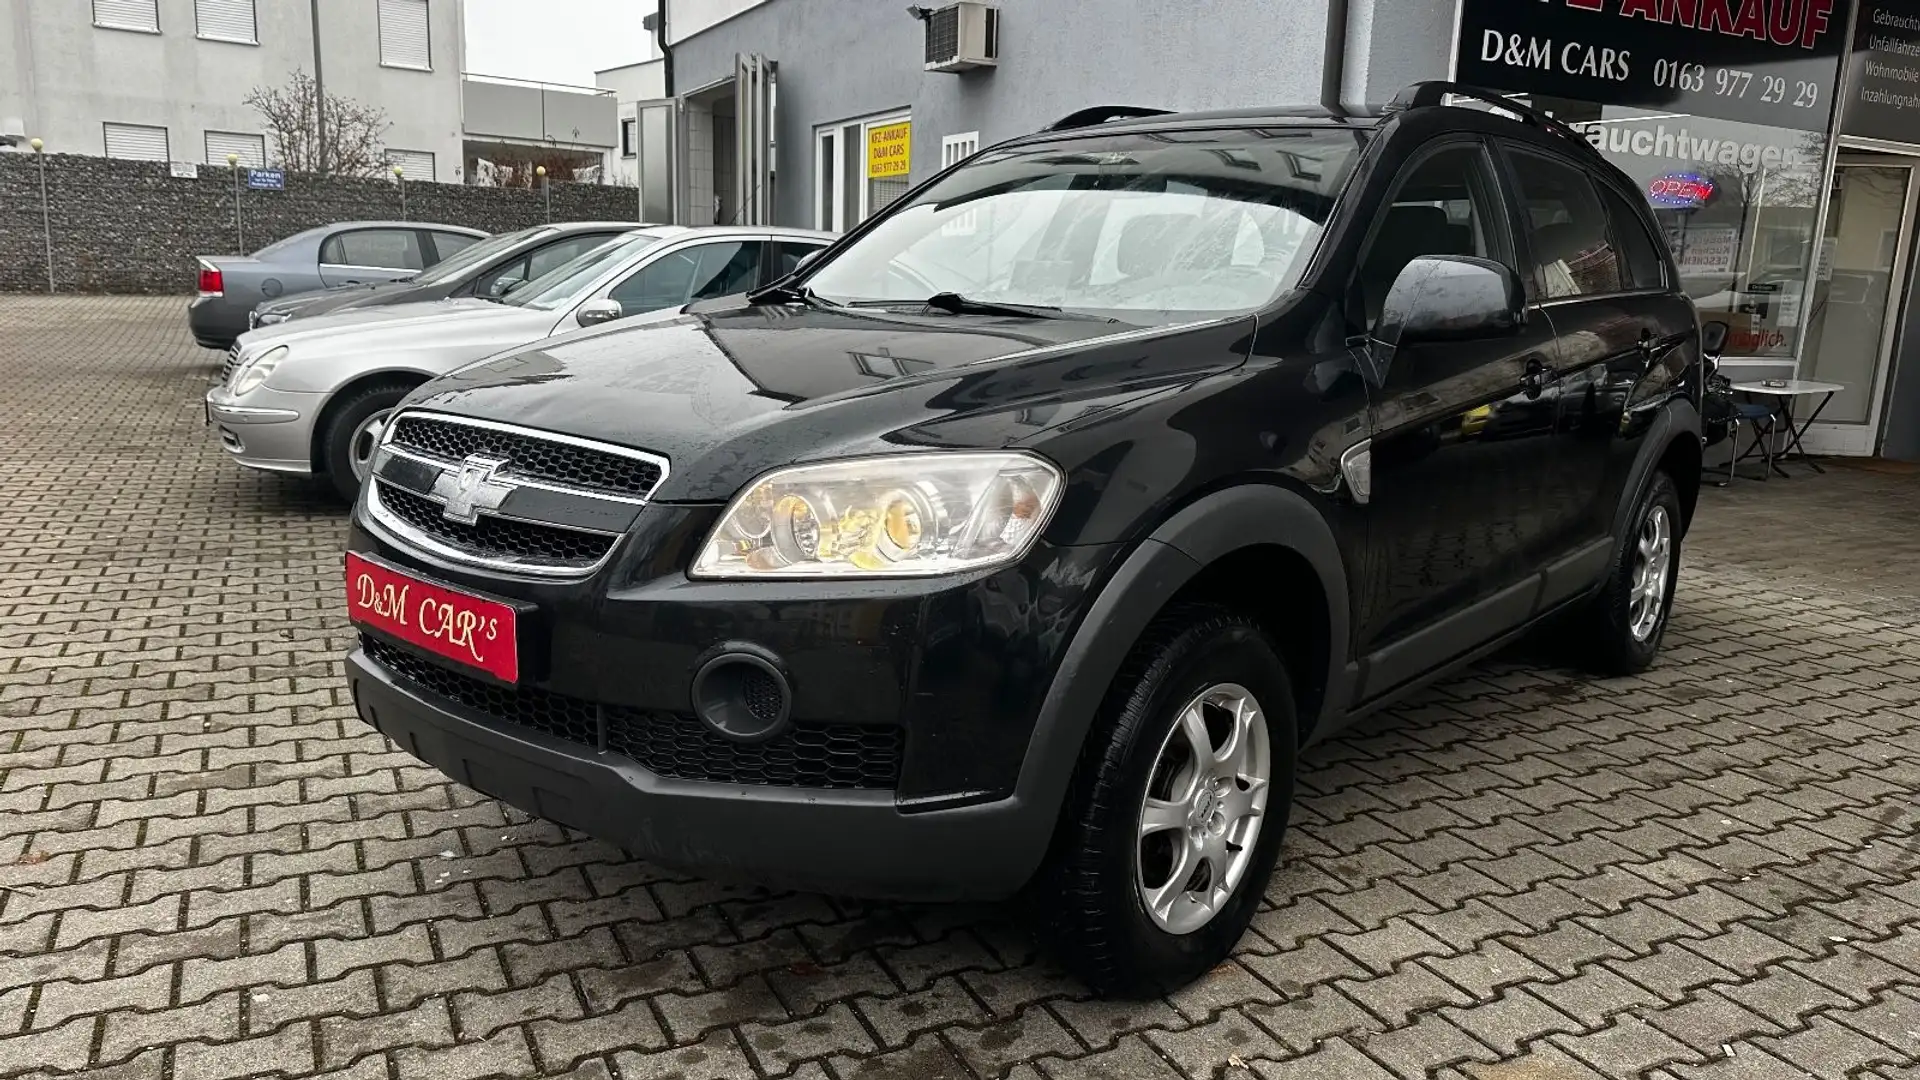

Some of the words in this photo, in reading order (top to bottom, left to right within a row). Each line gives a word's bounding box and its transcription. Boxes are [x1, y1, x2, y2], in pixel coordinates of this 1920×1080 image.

[1481, 29, 1551, 70] D&M
[1561, 42, 1631, 81] CARS
[1653, 58, 1706, 92] 0163
[1715, 68, 1754, 98] 977
[1760, 75, 1786, 104] 29
[1793, 80, 1818, 108] 29
[1865, 59, 1919, 83] Wohnmobile
[1861, 86, 1920, 109] Inzahlungnah
[890, 143, 904, 157] CARS
[250, 169, 281, 180] Parken
[1651, 180, 1713, 200] OPEN
[356, 573, 409, 625] D&M
